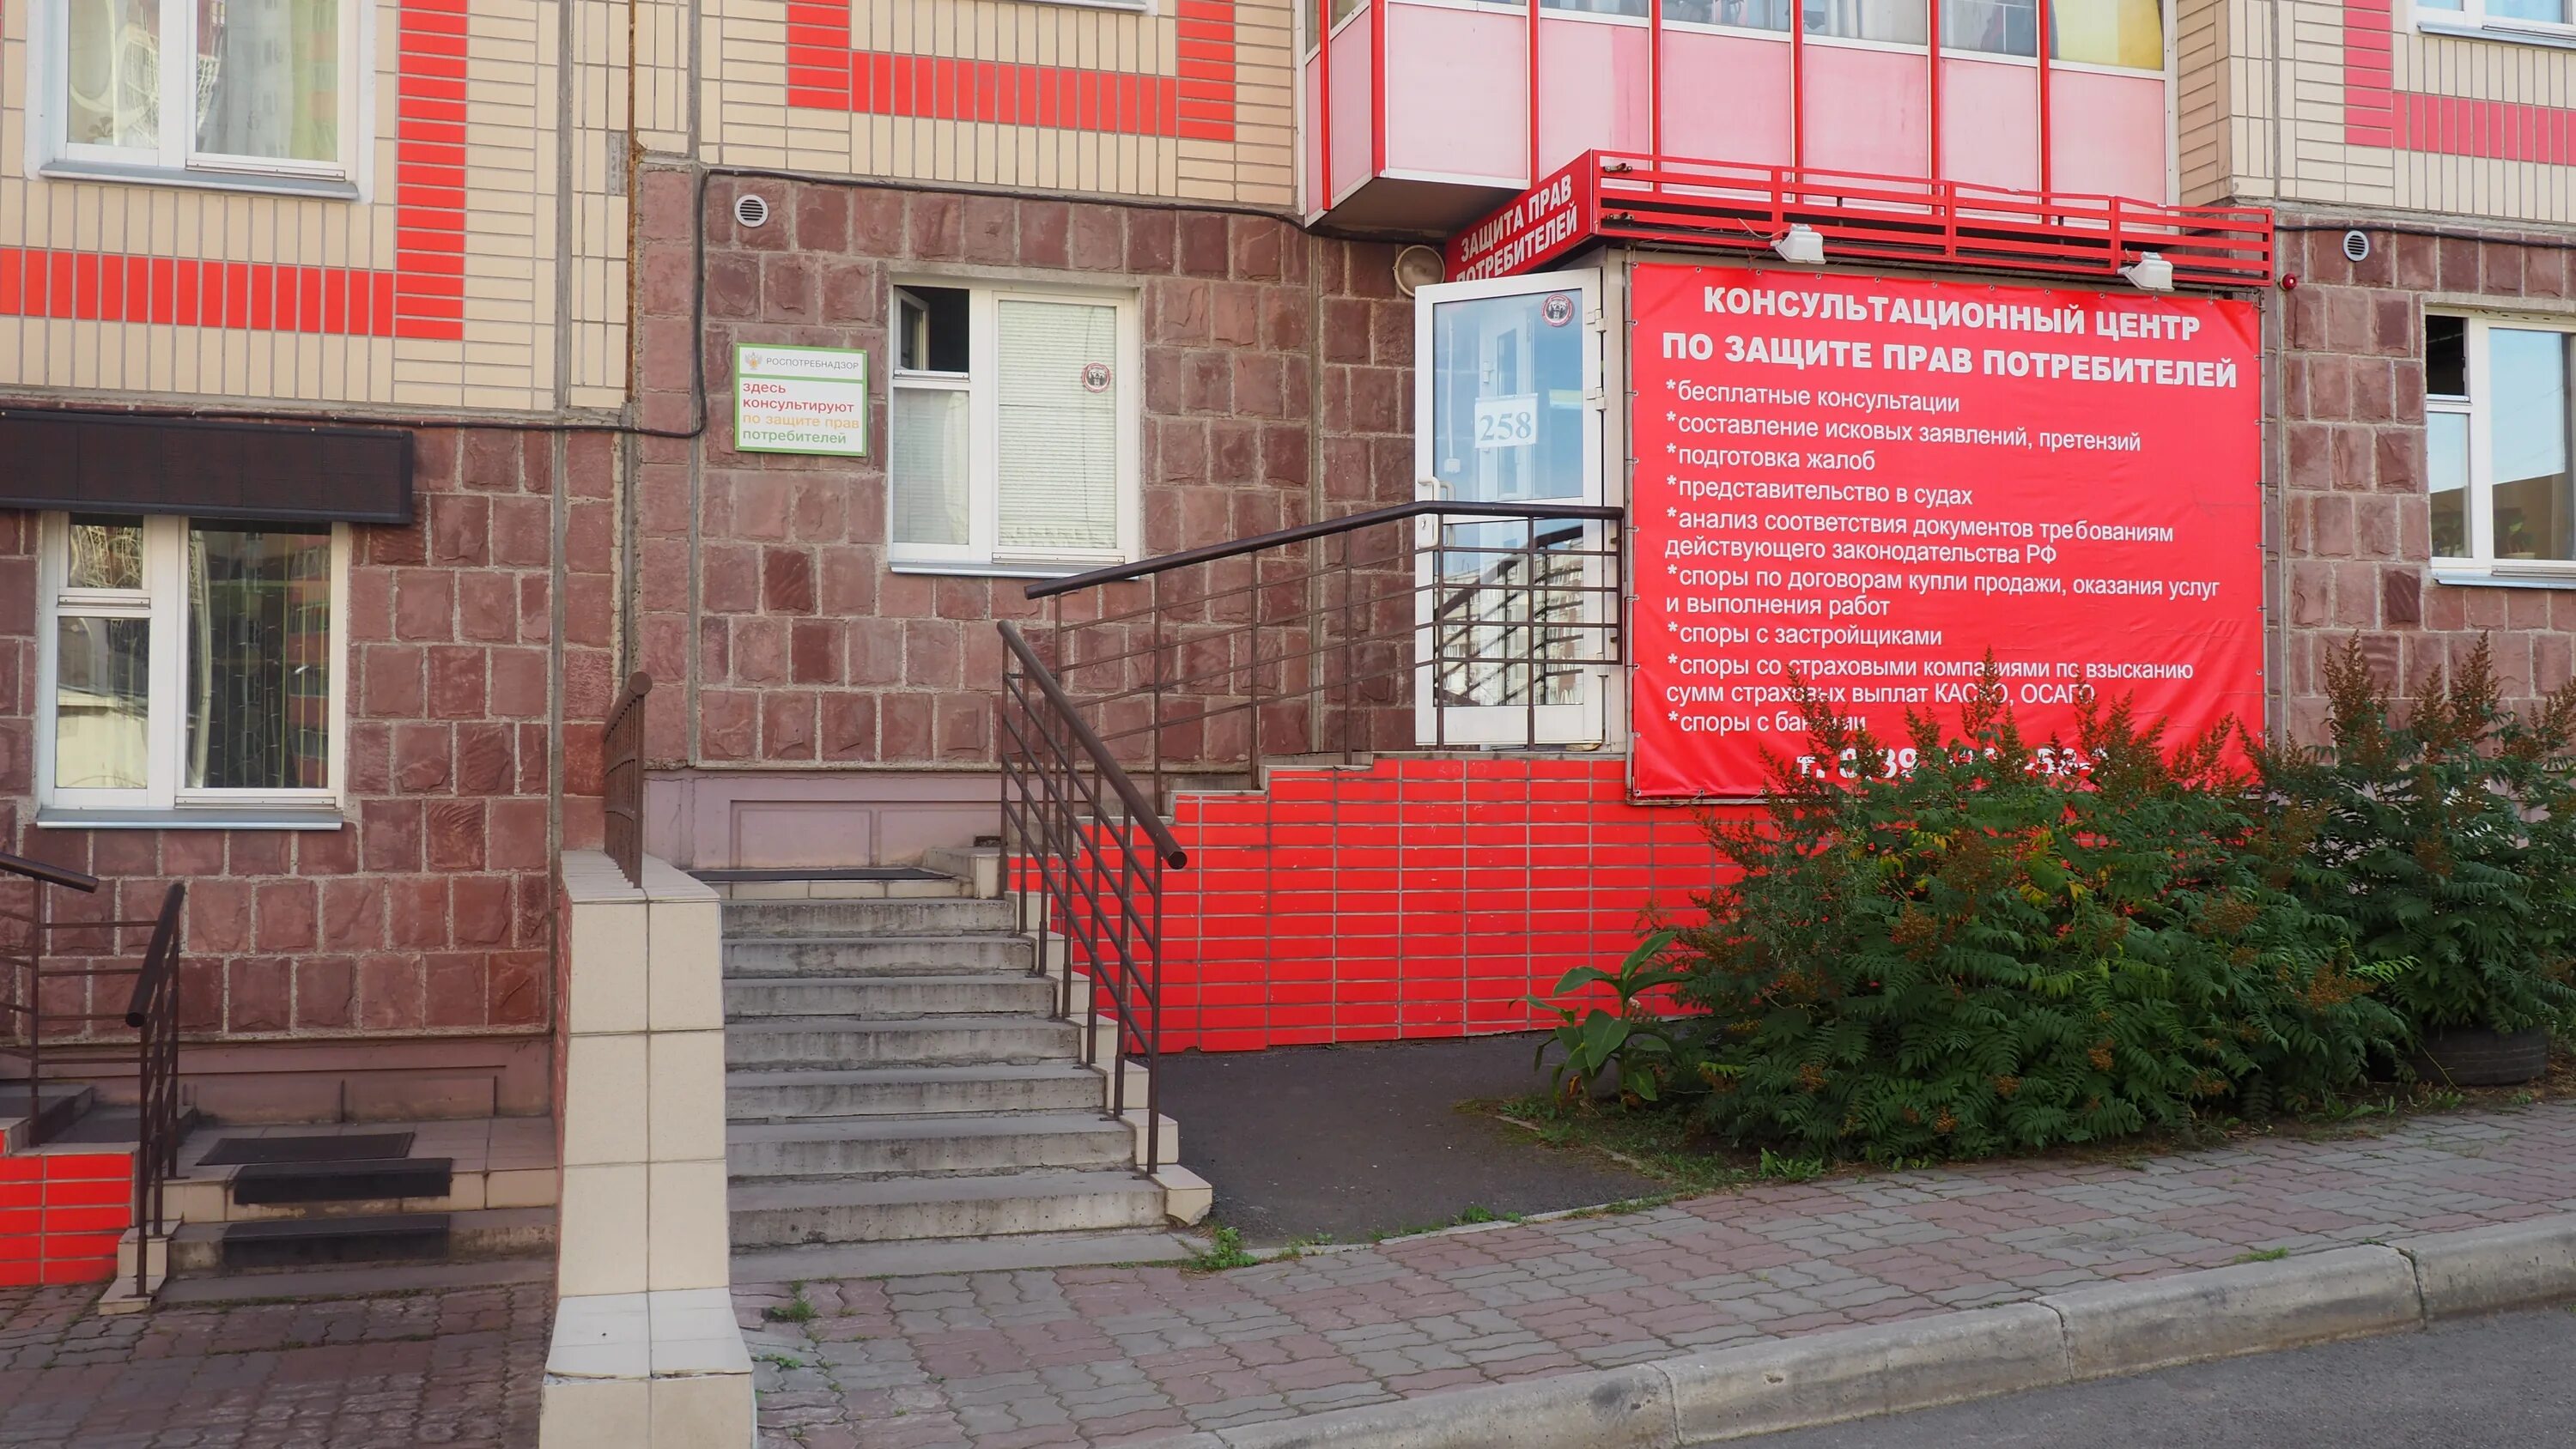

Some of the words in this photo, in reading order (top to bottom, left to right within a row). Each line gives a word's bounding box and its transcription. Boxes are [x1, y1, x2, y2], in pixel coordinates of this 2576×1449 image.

[1461, 204, 1525, 263] ЗАЩИТА
[1528, 174, 1573, 224] ПРАВ
[1704, 286, 2085, 335] КОНСУЛЬТАЦИОННЫЙ
[2096, 311, 2201, 342] ЦЕНТР
[766, 357, 860, 371] РОСПОТРЕБНАДЗОР
[1662, 331, 1714, 361] ПО
[1724, 335, 1873, 371] ЗАЩИТЕ
[1883, 343, 1973, 373] ПРАВ
[1983, 349, 2237, 388] ПОТРЕБИТЕЛЕЙ
[743, 383, 787, 395] здесь
[743, 399, 855, 414] консультируют
[1818, 391, 1959, 415] консультации
[743, 415, 761, 424] по
[766, 415, 822, 428] защите
[825, 419, 860, 431] прав
[1479, 411, 1533, 441] 258
[743, 430, 848, 445] потребителей
[1826, 422, 1913, 441] исковых
[1918, 426, 2032, 450] заявлений,
[2039, 432, 2141, 453] претензий
[1806, 450, 1875, 471] жалоб
[1896, 487, 1908, 503] в
[1914, 488, 1973, 509] судах
[1765, 514, 1907, 534] соответствия
[1912, 518, 2034, 541] документов
[2038, 519, 2173, 543] требованиям
[1664, 535, 1826, 562] действующего
[1832, 543, 2020, 564] законодательства
[2026, 543, 2057, 565] РФ
[1756, 571, 1782, 587] по
[1787, 571, 1902, 594] договорам
[1909, 574, 1967, 595] купли
[1974, 576, 2067, 597] продажи,
[2073, 579, 2163, 596] оказания
[2168, 580, 2221, 602] услуг
[1666, 597, 1680, 613] и
[1686, 597, 1822, 615] выполнения
[1829, 594, 1891, 620] работ
[1756, 627, 1769, 644] с
[1774, 624, 1942, 649] застройщиками
[1756, 658, 1782, 676] со
[1923, 661, 2050, 677] компаиями
[2086, 663, 2194, 679] взысканию
[1666, 686, 1724, 707] сумм
[1852, 687, 1929, 703] выплат
[2020, 683, 2095, 704] ОСАГО
[1757, 715, 1770, 732] с
